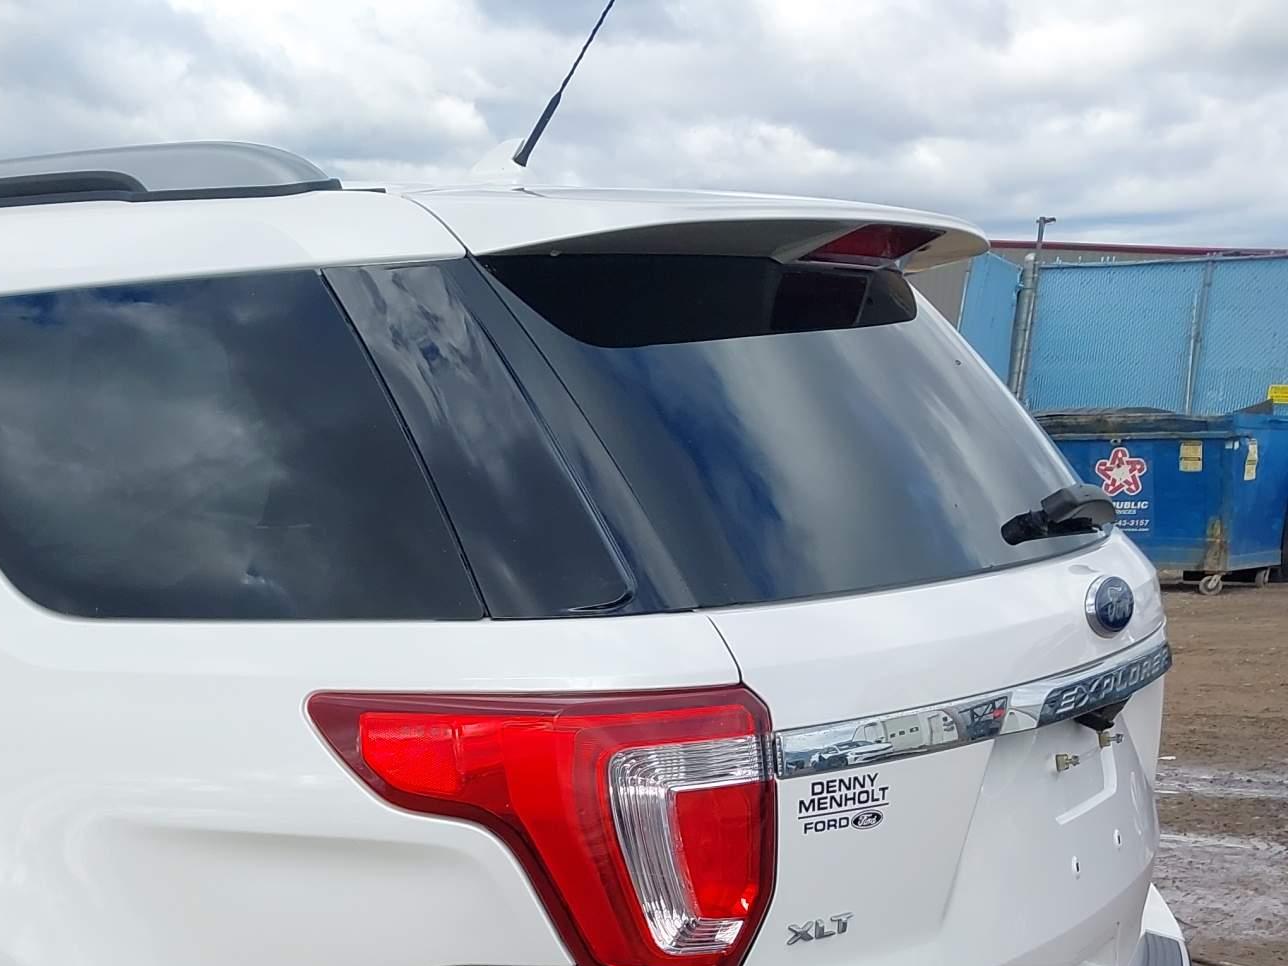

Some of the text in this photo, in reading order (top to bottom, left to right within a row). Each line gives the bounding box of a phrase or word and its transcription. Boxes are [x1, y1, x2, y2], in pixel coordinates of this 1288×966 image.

[1056, 650, 1170, 714] EXPLORER
[811, 773, 878, 796] DENNY
[798, 786, 889, 814] MENHOLT
[803, 816, 850, 834] FORD
[786, 911, 854, 946] XLT
